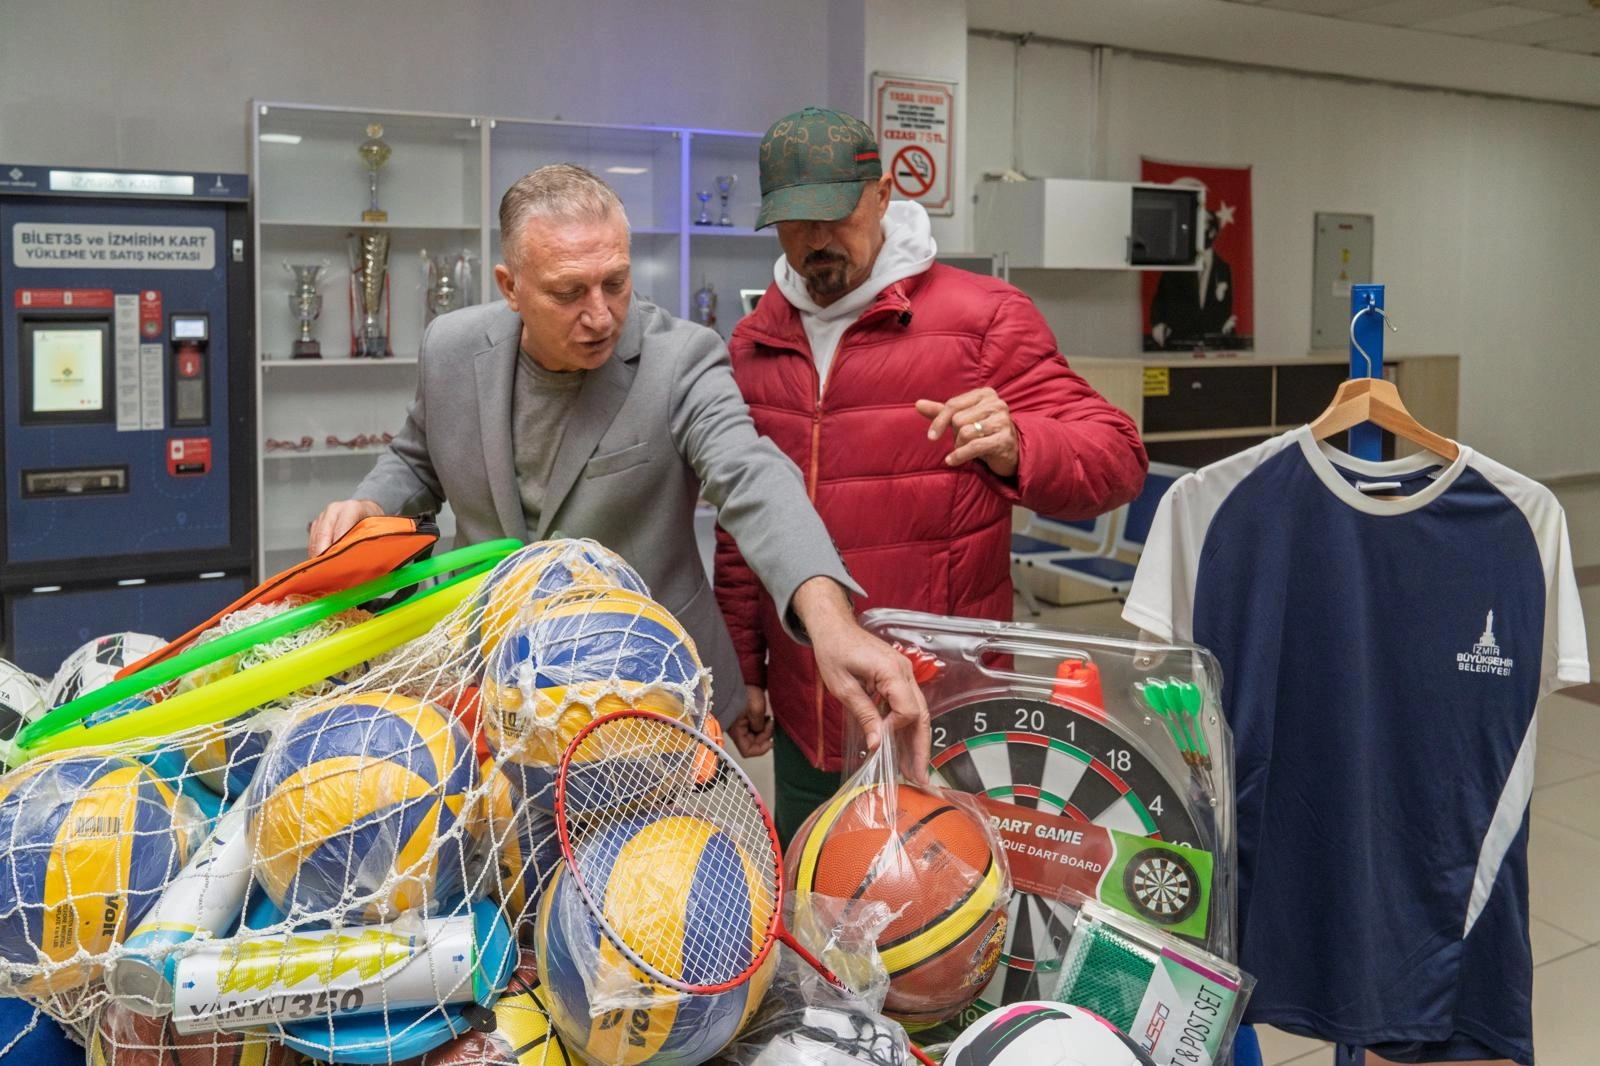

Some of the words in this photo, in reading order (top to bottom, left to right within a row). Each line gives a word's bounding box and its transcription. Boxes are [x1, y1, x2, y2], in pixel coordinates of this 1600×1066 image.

[21, 230, 82, 246] BİLET35
[87, 235, 103, 246] ve
[108, 231, 164, 247] İZMİRİM
[169, 236, 207, 248] KART
[26, 247, 86, 260] YÜKLEME
[92, 250, 106, 260] VE
[109, 250, 143, 262] SATIŞ
[147, 250, 200, 261] NOKTASI
[973, 712, 987, 732] 5
[1014, 708, 1044, 731] 20
[1066, 721, 1076, 741] 1
[1106, 749, 1131, 771] 18
[1148, 794, 1164, 816] 4
[990, 815, 1032, 834] DART
[1035, 824, 1084, 845] GAME
[1001, 839, 1026, 853] QUE
[1027, 846, 1059, 862] DART
[1060, 856, 1102, 873] BOARD
[1194, 984, 1223, 1016] SET
[1140, 1002, 1170, 1057] USSO
[1180, 1010, 1213, 1052] POST
[1175, 1048, 1199, 1063] &
